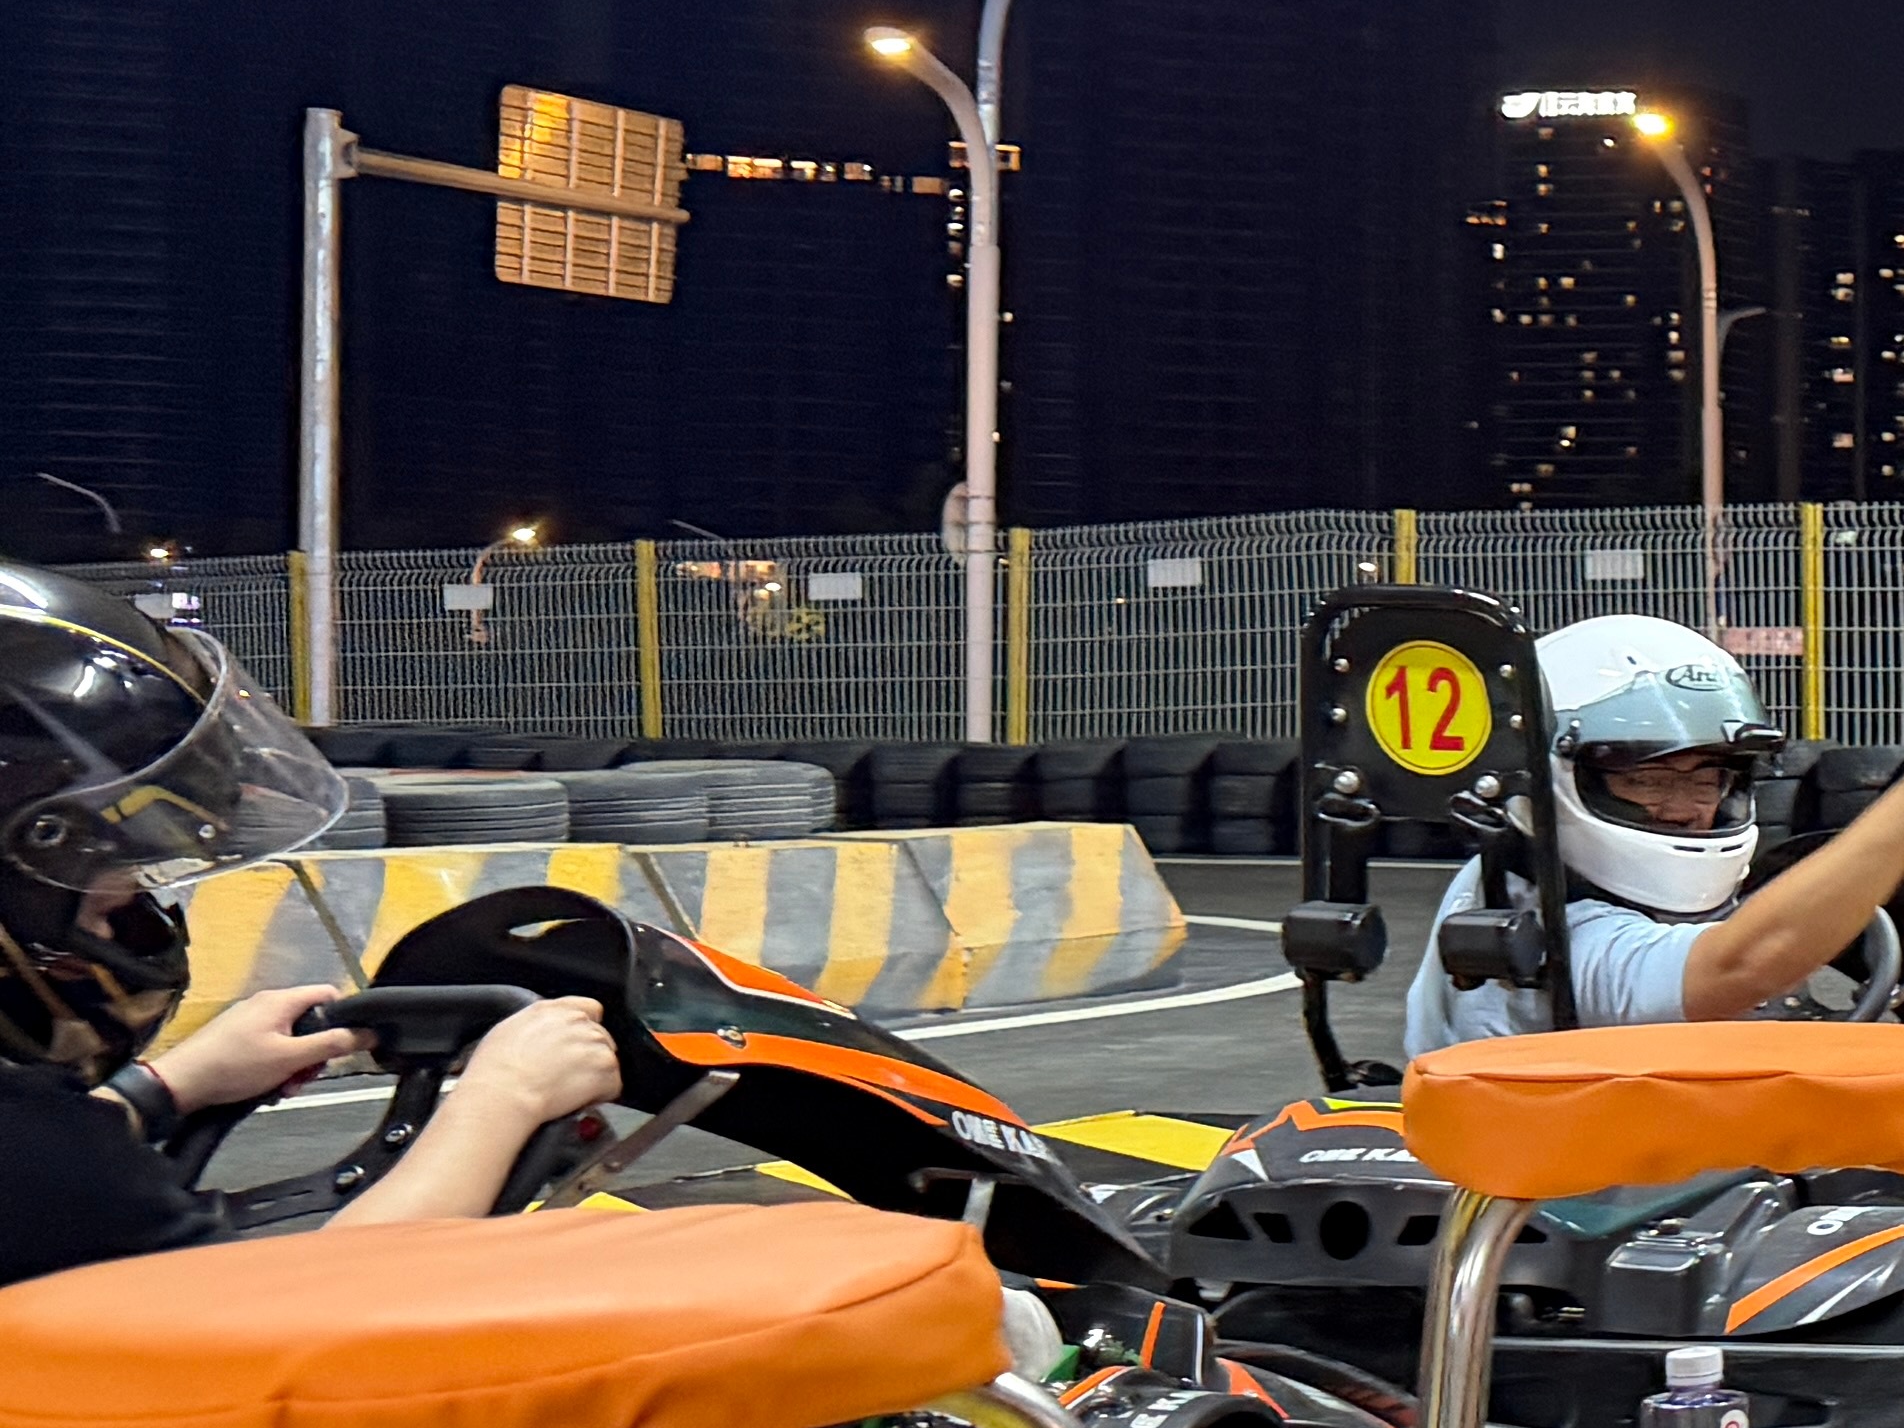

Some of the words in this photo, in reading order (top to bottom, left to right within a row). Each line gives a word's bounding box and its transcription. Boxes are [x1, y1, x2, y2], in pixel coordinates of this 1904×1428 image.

[1383, 664, 1467, 753] 12
[952, 1110, 1006, 1150] ONE
[1361, 1148, 1419, 1163] KA
